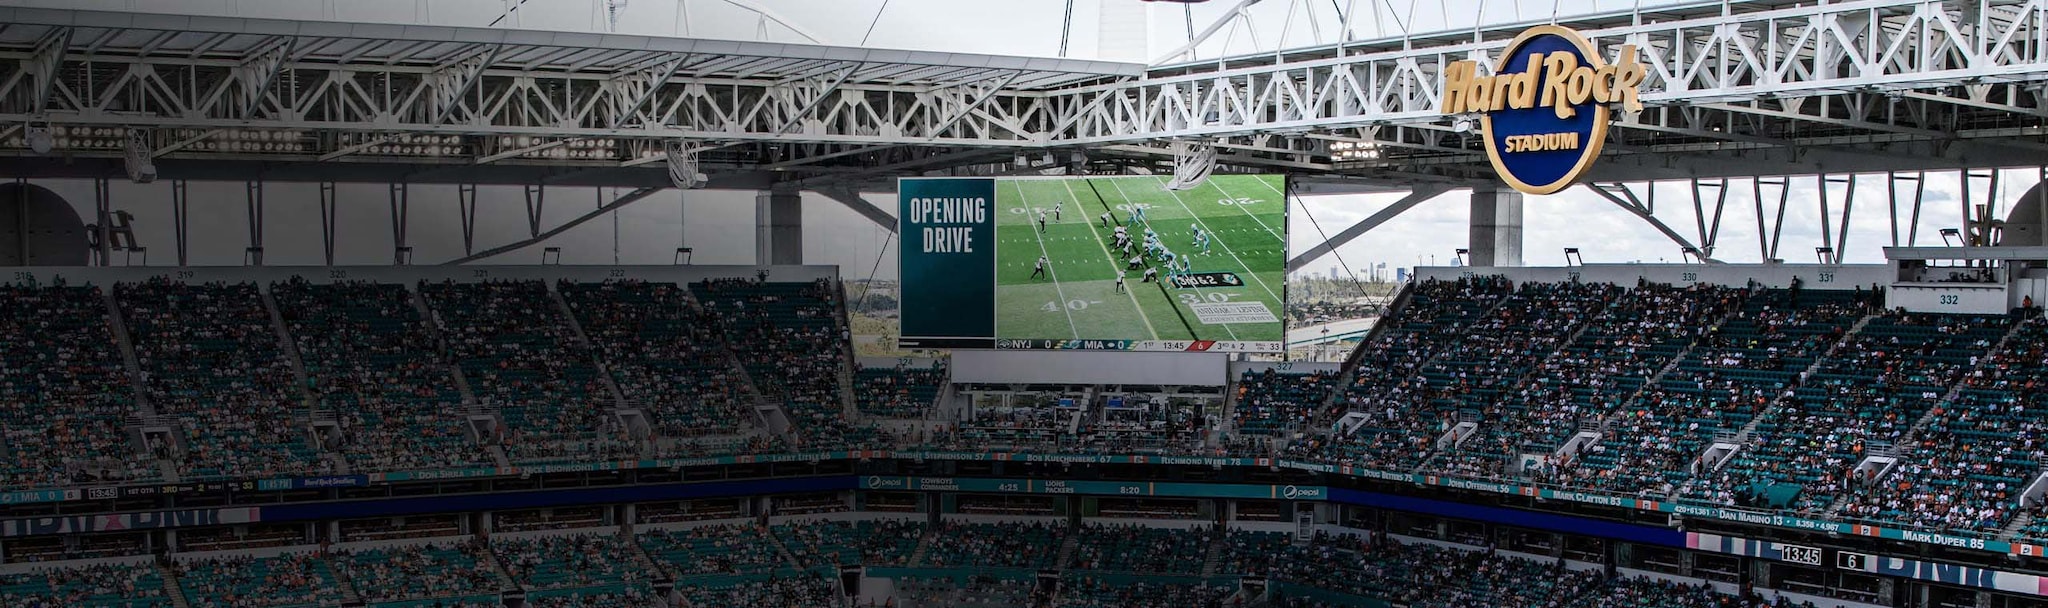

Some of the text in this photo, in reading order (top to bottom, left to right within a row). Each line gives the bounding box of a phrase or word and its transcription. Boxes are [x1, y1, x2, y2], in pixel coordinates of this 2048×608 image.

[1441, 44, 1646, 119] Hard Rock
[1504, 132, 1579, 153] STADIUM
[910, 197, 986, 224] OPENING
[923, 227, 973, 253] DRIVE
[177, 270, 194, 279] 319
[329, 270, 346, 279] 320
[472, 269, 488, 278] 321
[609, 268, 626, 277] 322
[1682, 272, 1696, 282] 330
[1818, 272, 1834, 283] 331
[1206, 275, 1218, 285] 2
[1939, 294, 1958, 306] 332
[1012, 341, 1052, 349] NYJ 0
[1084, 341, 1125, 350] MIA 0
[1163, 342, 1184, 350] 13:45
[1197, 342, 1204, 350] 6
[1276, 362, 1292, 370] 327
[820, 453, 831, 461] 66
[925, 451, 972, 460] STEPHENSON
[1027, 454, 1043, 462] BOB
[1161, 456, 1201, 465] RICHMOND
[1231, 458, 1241, 466] 78
[1325, 465, 1334, 473] 73
[1364, 469, 1380, 478] DOUG
[1405, 474, 1413, 482] 75
[881, 478, 902, 488] pepsi
[999, 483, 1018, 491] 4:25
[1448, 478, 1465, 488] JOHN
[1500, 485, 1510, 494] 56
[1120, 486, 1140, 494] 8:20
[1297, 488, 1319, 498] pepsi
[21, 493, 41, 503] MIA
[49, 491, 55, 499] 0
[90, 489, 115, 498] 13:45
[1553, 490, 1621, 506] MARK CLAYTON 83
[1720, 511, 1737, 521] DAN
[1738, 513, 1771, 525] MARINO
[1773, 516, 1783, 526] 13
[1902, 530, 1985, 549] MARK DUPER 85
[1784, 545, 1819, 564] 13:45
[1848, 554, 1857, 569] 6
